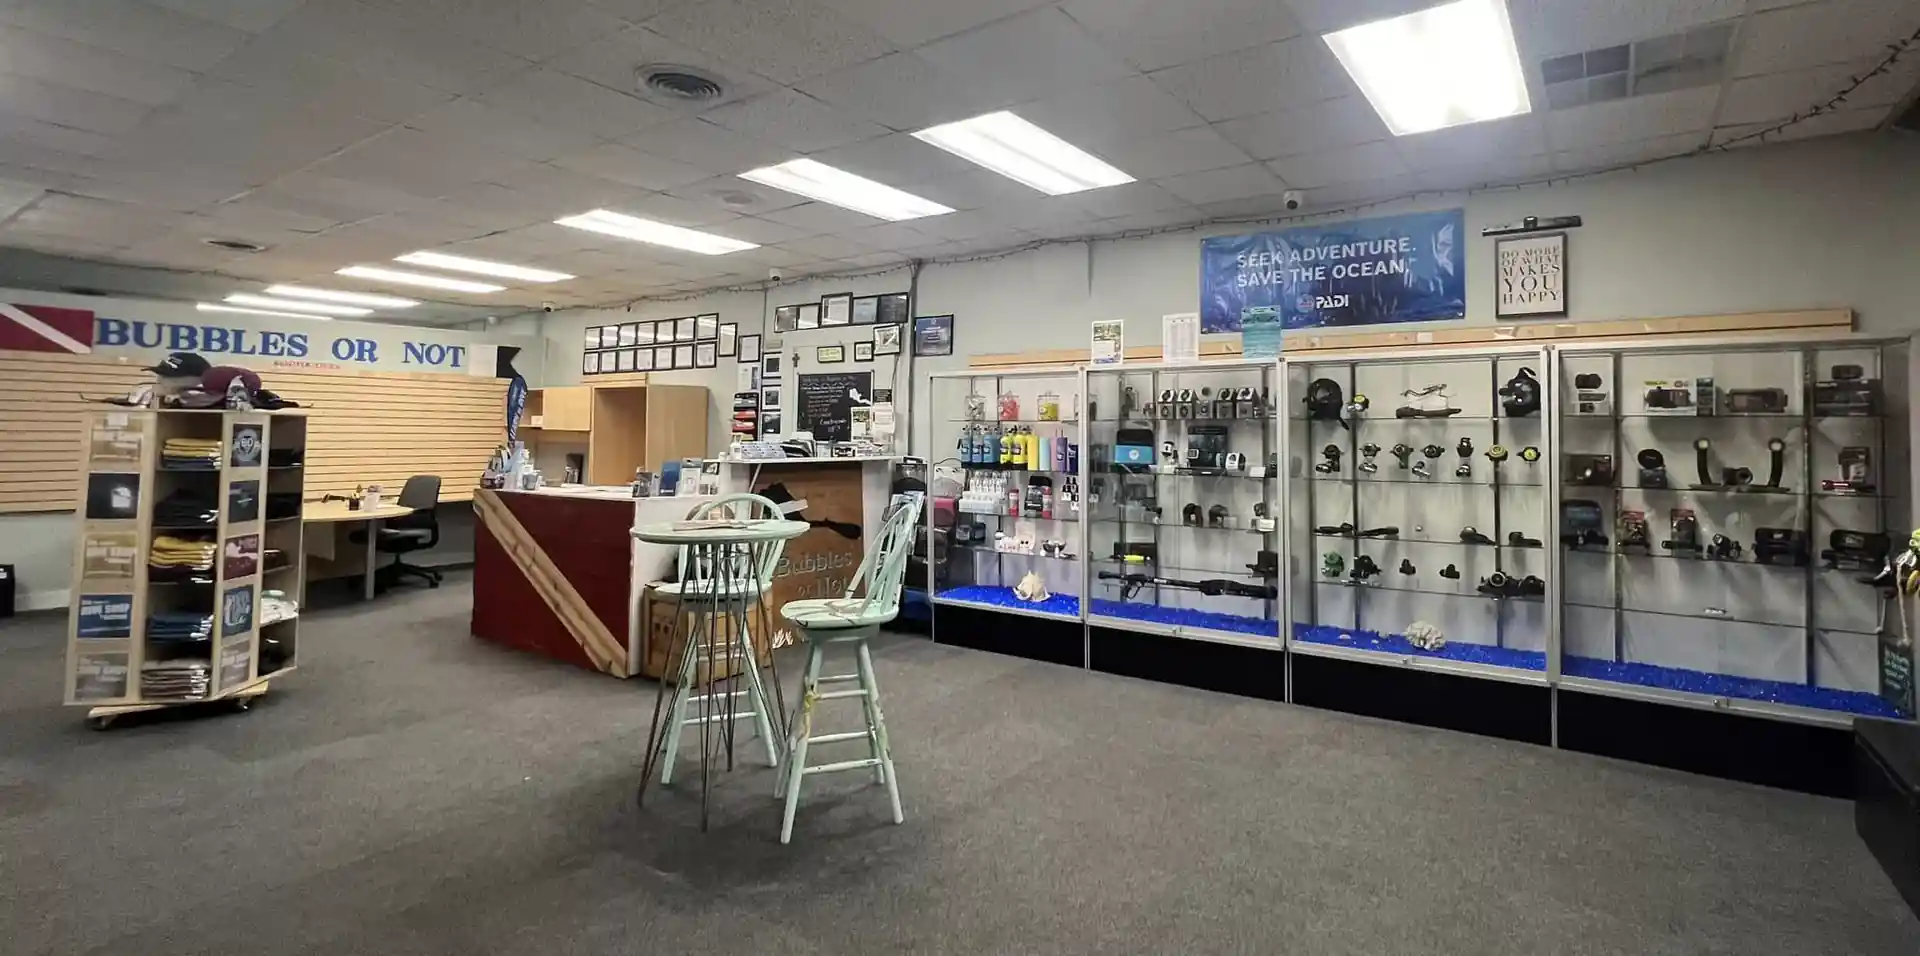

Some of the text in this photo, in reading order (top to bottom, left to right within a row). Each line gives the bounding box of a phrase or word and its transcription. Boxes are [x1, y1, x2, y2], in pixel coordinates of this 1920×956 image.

[1237, 237, 1417, 268] SEEK ADVENTURE.
[1502, 245, 1560, 259] DO MORE
[1502, 254, 1559, 267] OF WHAT
[1237, 271, 1283, 288] SAVE
[1290, 266, 1326, 283] THE
[1504, 264, 1561, 276] MAKES
[1504, 275, 1556, 293] YOU
[1316, 294, 1350, 309] PADI
[1503, 291, 1559, 304] HAPPY
[96, 318, 465, 368] BUBBLES OR NOT
[776, 551, 852, 578] Bubbles
